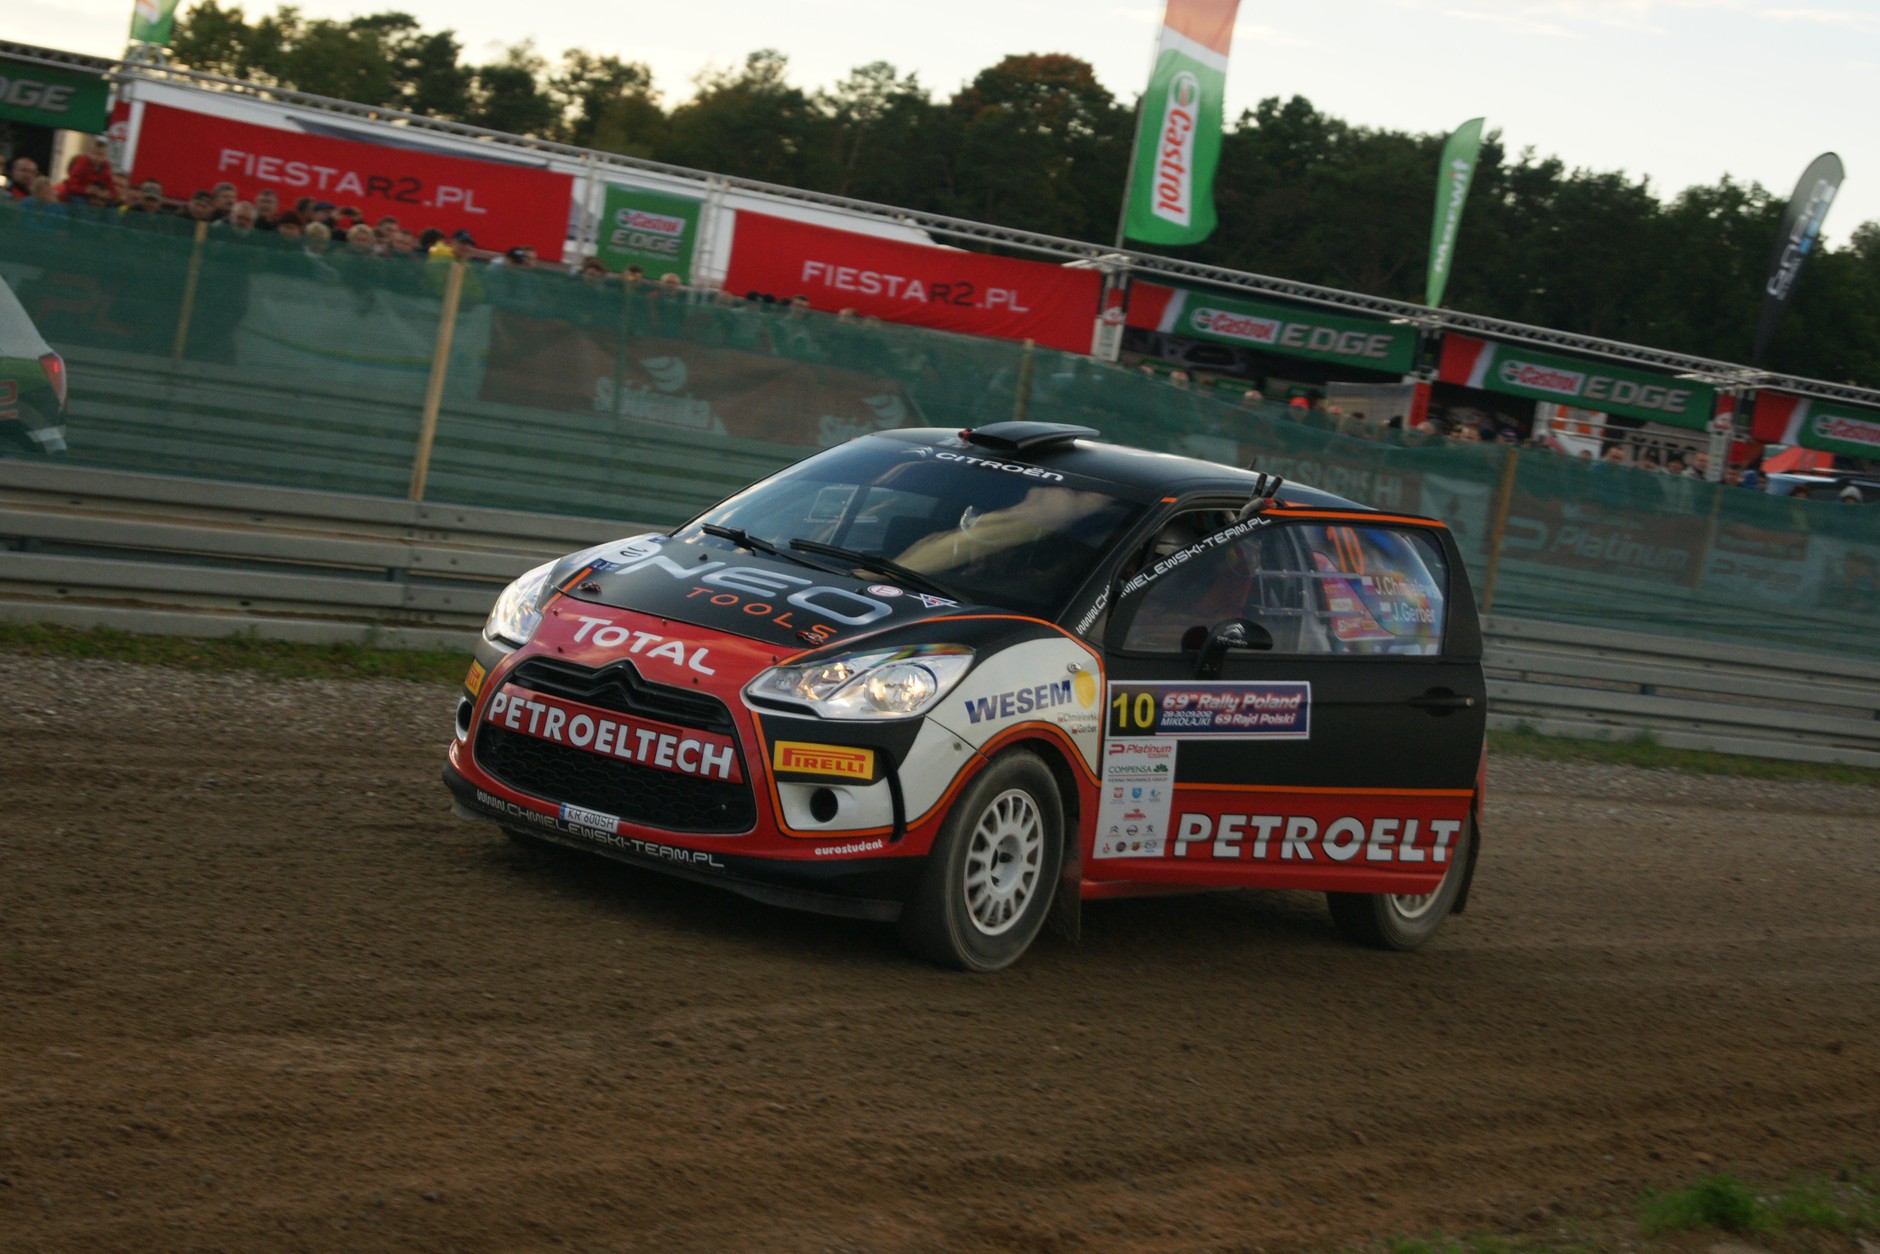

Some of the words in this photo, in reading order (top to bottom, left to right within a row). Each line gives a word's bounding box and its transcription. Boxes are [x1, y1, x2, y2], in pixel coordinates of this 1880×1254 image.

[0, 76, 76, 112] GE
[218, 148, 487, 215] FIESTAR2.PL
[1157, 108, 1192, 214] Castrol
[610, 229, 684, 255] EDGE
[801, 260, 1030, 313] FIESTAR2.PL
[1211, 312, 1278, 340] Castrol
[1280, 322, 1394, 359] EDGE
[1518, 366, 1578, 392] Castrol
[1584, 375, 1693, 413] EDGE
[1326, 525, 1365, 576] 10
[615, 554, 893, 626] NEO
[686, 586, 838, 641] TOOLS
[572, 616, 716, 676] TOTAL
[964, 679, 1073, 725] WESEM
[1112, 692, 1155, 728] 10
[1198, 694, 1240, 712] Rally
[1241, 694, 1302, 709] Poland
[1214, 713, 1232, 724] 69
[1233, 714, 1258, 727] Rajd
[1259, 713, 1296, 724] Polski
[488, 691, 735, 780] PETROELTECH
[1126, 744, 1172, 754] Platinum
[782, 746, 866, 774] PIRELLI
[1108, 765, 1152, 774] COMPENSA
[476, 789, 725, 868] WWW.CHMIELEWSKI-TEAM.PL
[567, 807, 582, 822] KR
[583, 812, 615, 830] 600SH
[1172, 812, 1463, 863] PETROELT
[814, 839, 883, 856] eurostudent
